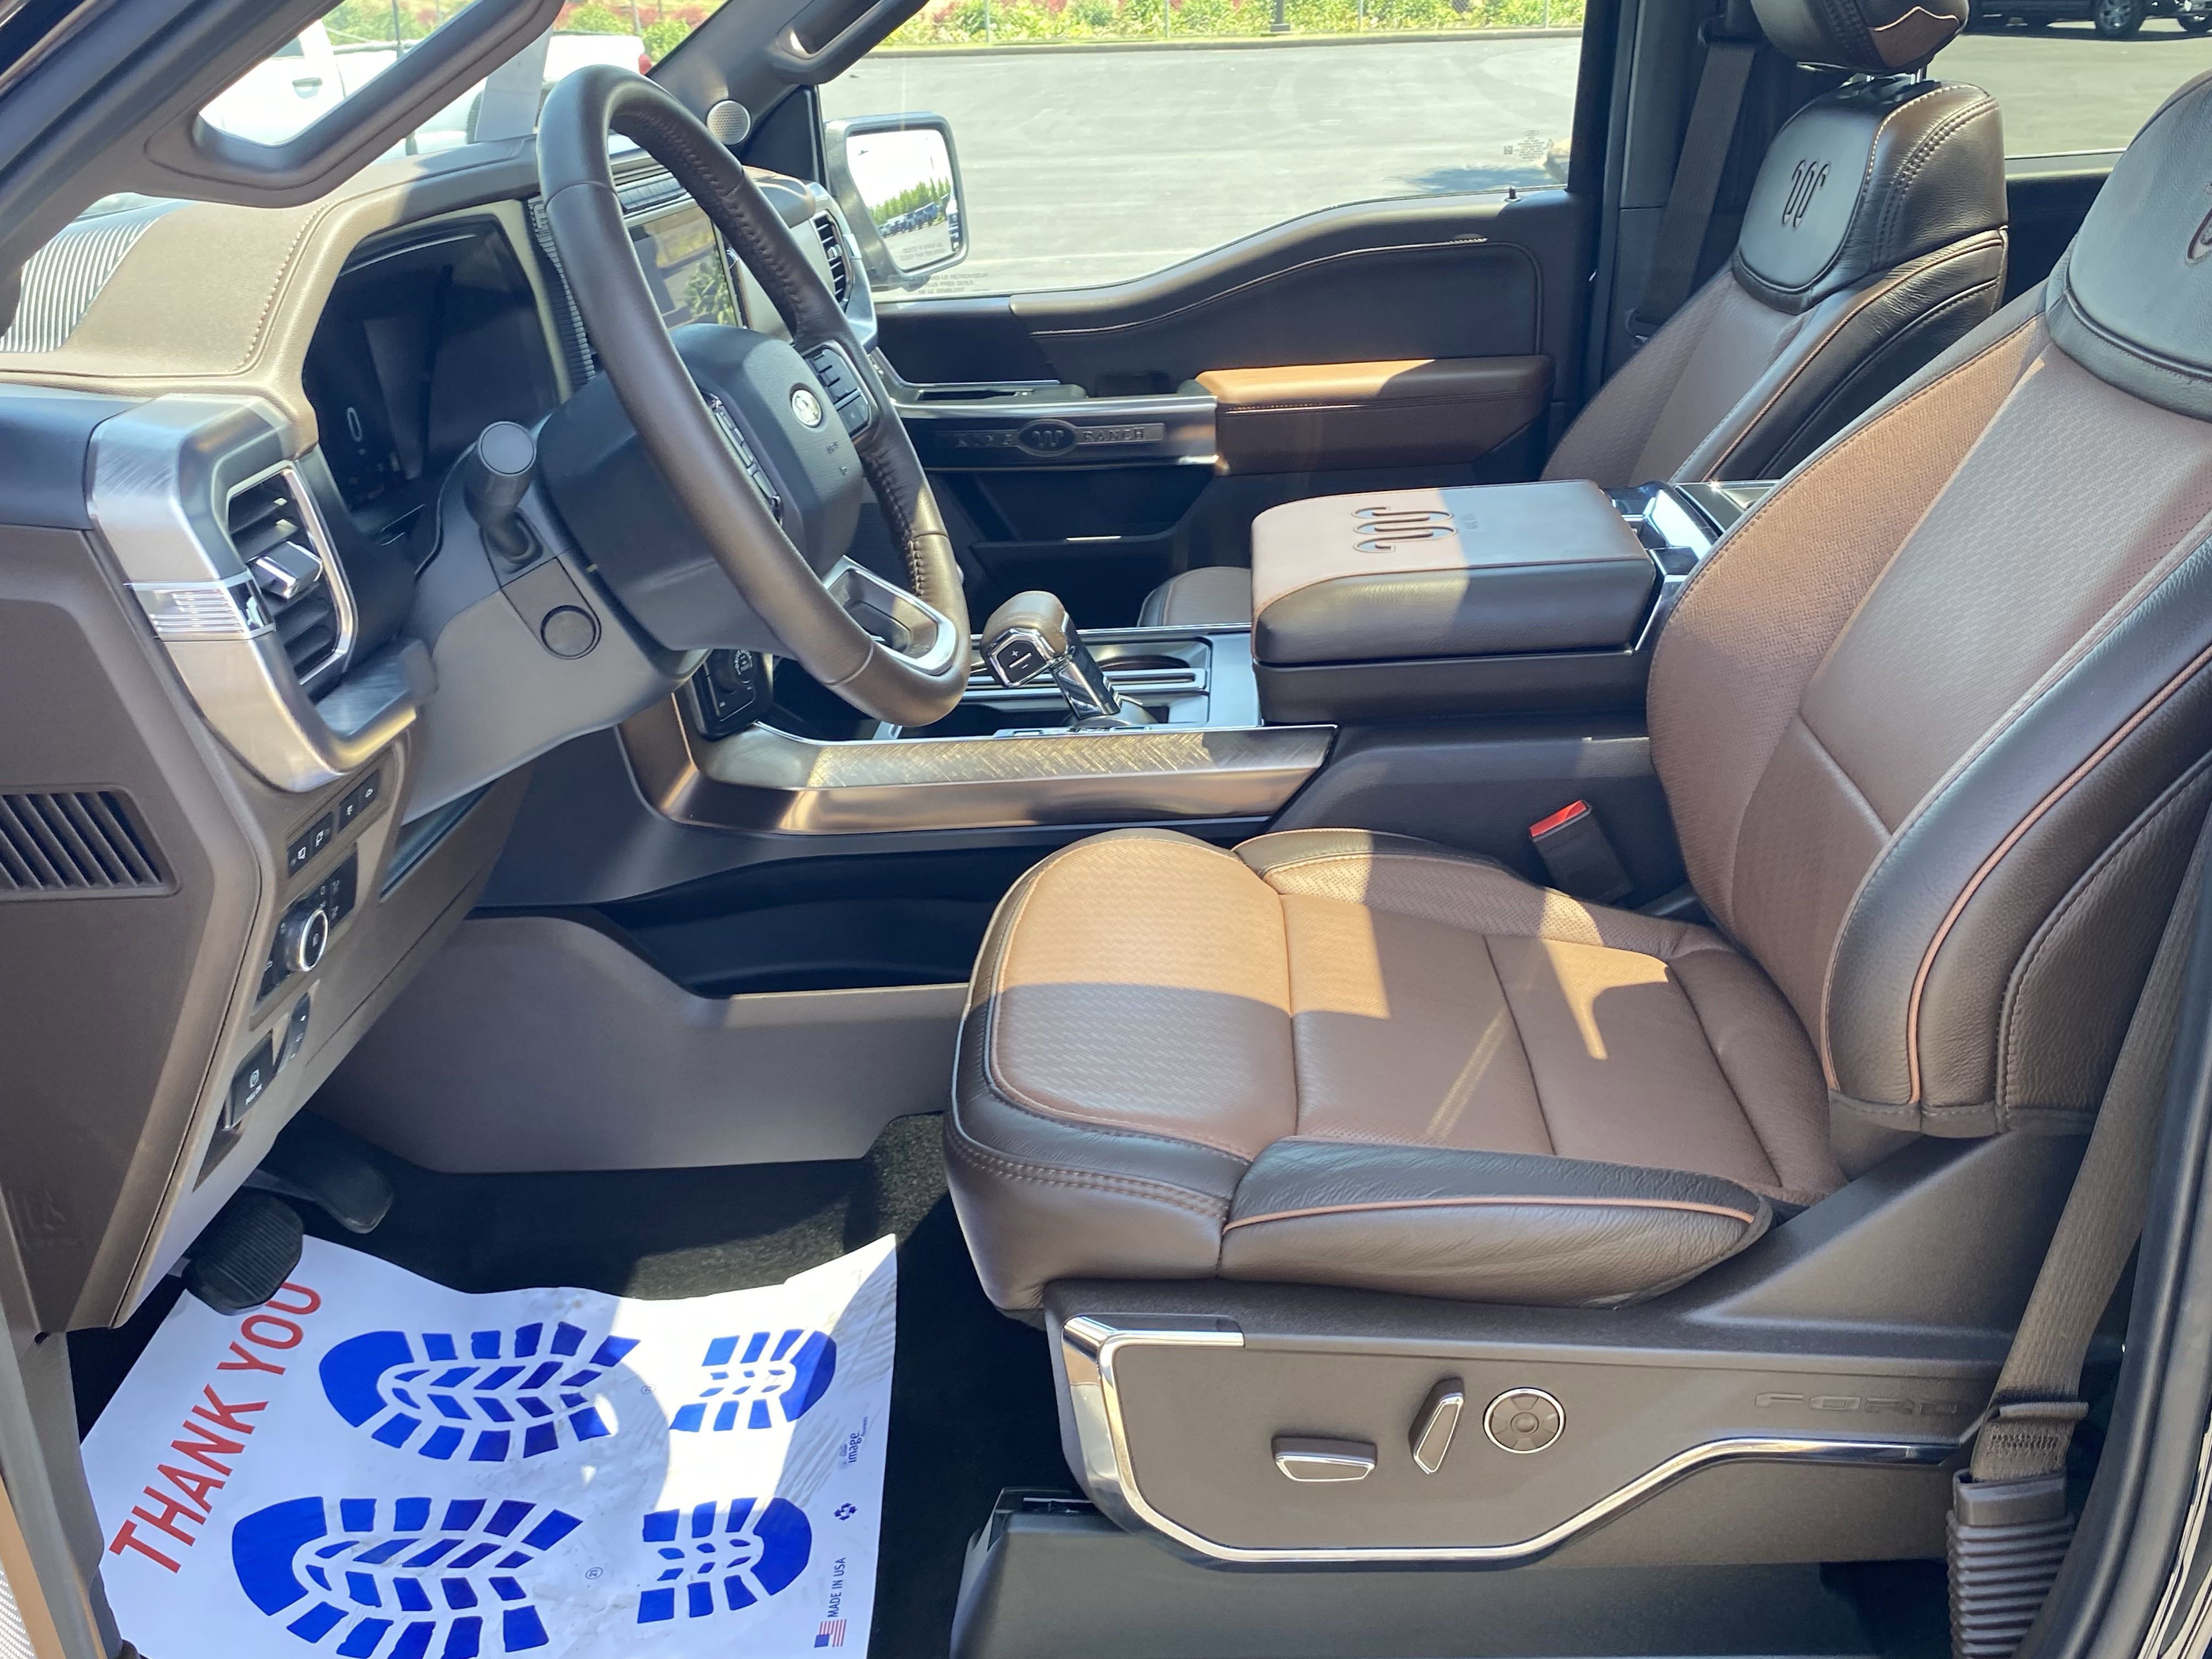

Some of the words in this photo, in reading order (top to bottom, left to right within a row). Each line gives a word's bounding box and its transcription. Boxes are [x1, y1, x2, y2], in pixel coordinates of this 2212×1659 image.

[1755, 1392, 1957, 1414] FORD
[109, 1383, 269, 1574] THANK
[216, 1281, 321, 1375] YOU
[844, 1430, 862, 1464] image
[832, 1556, 847, 1577] USA
[830, 1579, 844, 1590] IN
[826, 1592, 842, 1618] MADE
